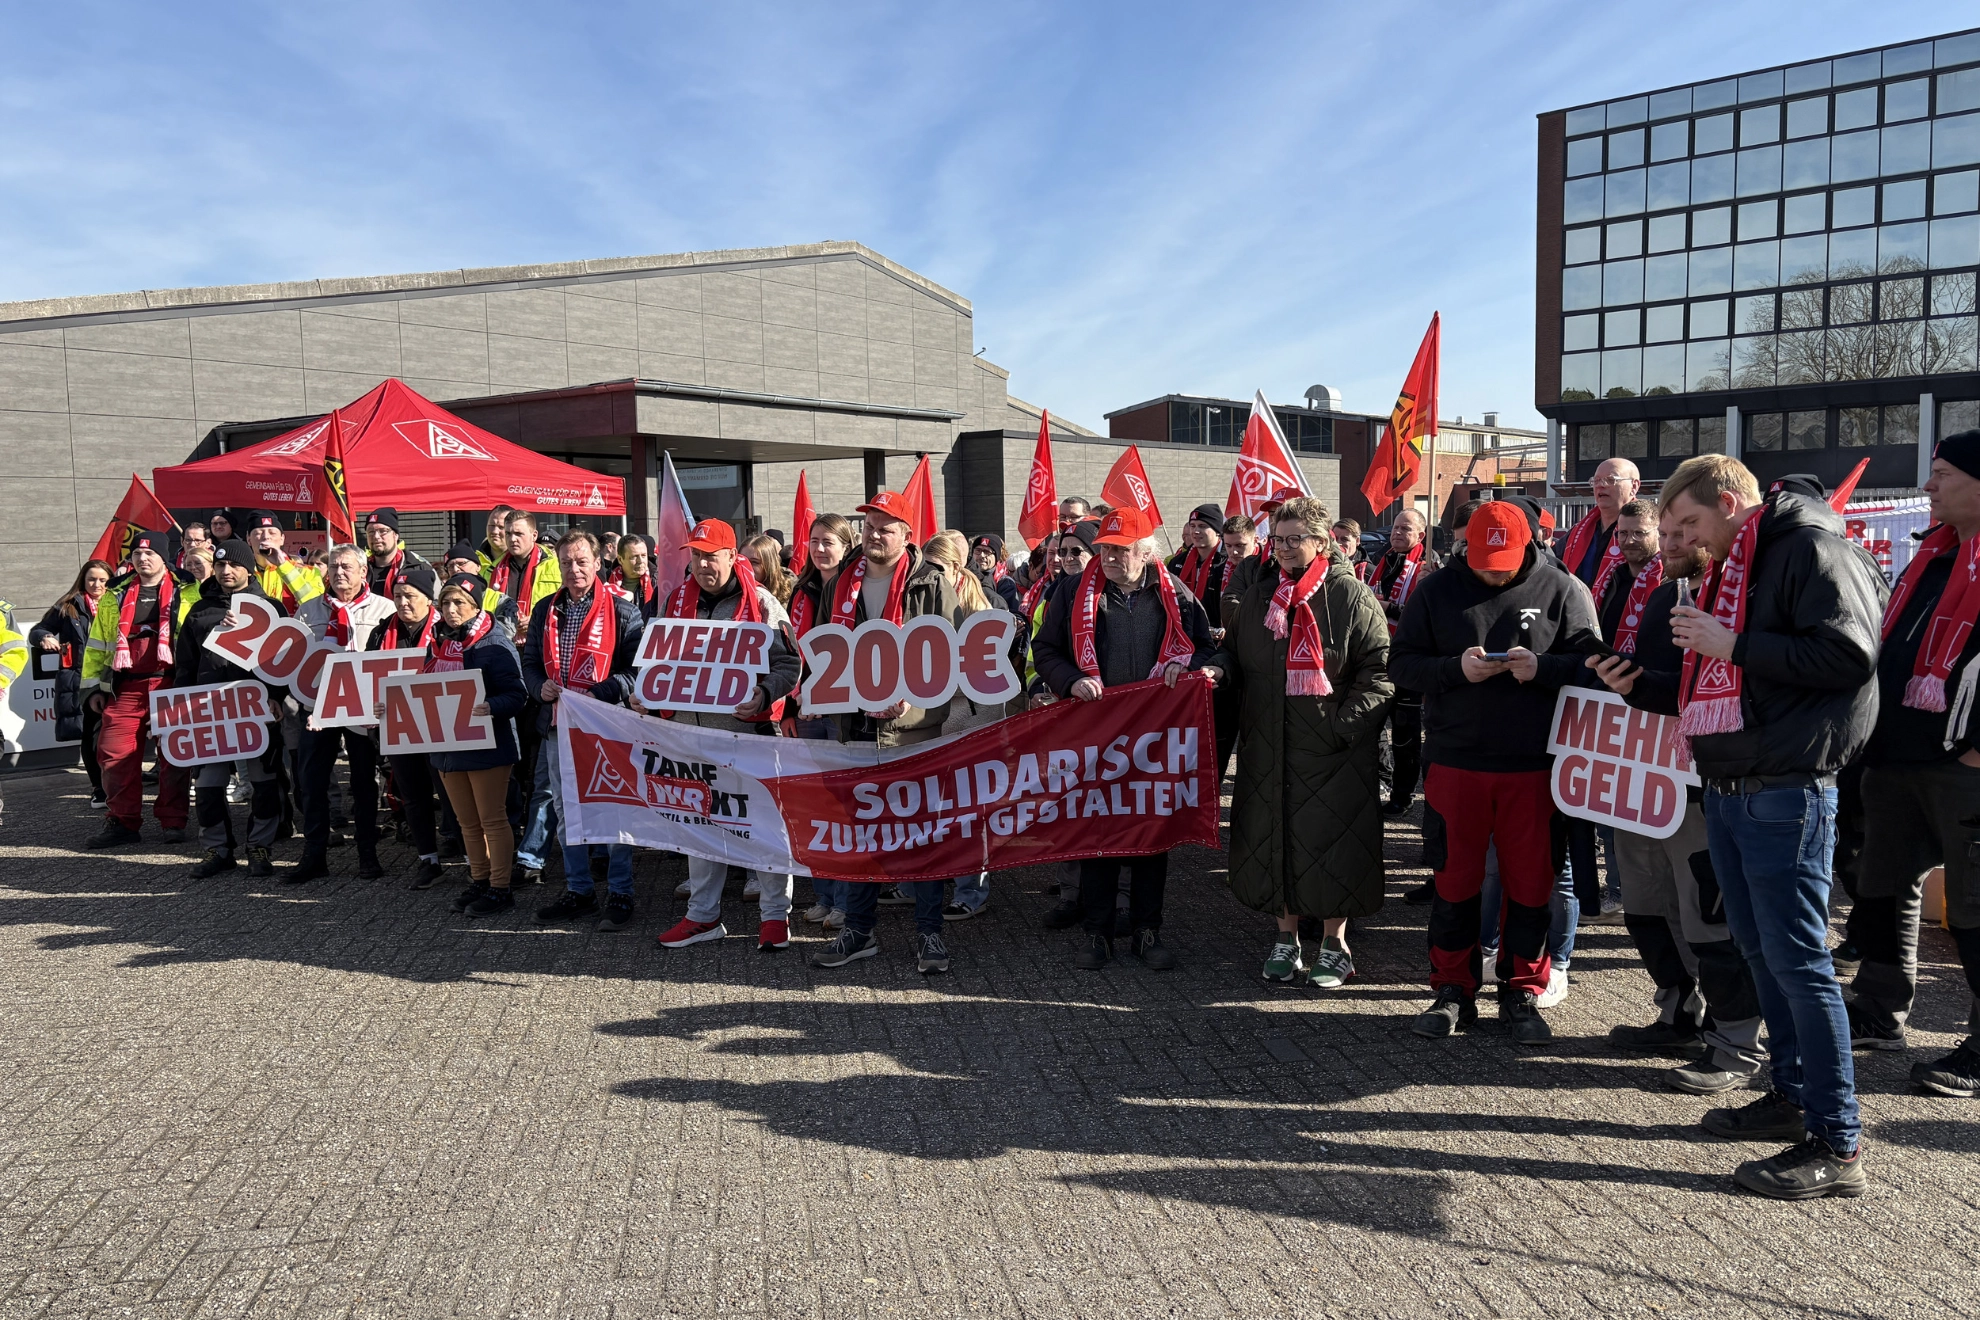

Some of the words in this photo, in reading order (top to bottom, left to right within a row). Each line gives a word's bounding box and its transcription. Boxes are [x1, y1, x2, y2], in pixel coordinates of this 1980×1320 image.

[245, 481, 275, 491] GEMEINSAM
[275, 481, 285, 491] FÜR
[285, 483, 295, 492] EIN
[262, 492, 278, 501] GUTES
[278, 493, 295, 502] LEBEN
[507, 485, 554, 497] GEMEINSAM
[554, 487, 570, 497] FÜR
[570, 489, 582, 498] EIN
[536, 497, 559, 505] GUTES
[560, 498, 582, 507] LEBEN
[1715, 556, 1745, 633] JETZT
[642, 624, 766, 665] MEHR
[809, 619, 1010, 705] 200€
[641, 664, 749, 706] GELD
[156, 685, 266, 728] MEHR
[385, 679, 487, 746] ATZ
[167, 721, 263, 761] GELD
[852, 727, 1199, 820] SOLIDARISCH
[1558, 754, 1677, 828] GELD
[683, 815, 691, 824] &
[988, 777, 1199, 835] GESTALTEN
[807, 814, 977, 853] ZUKUNFT
